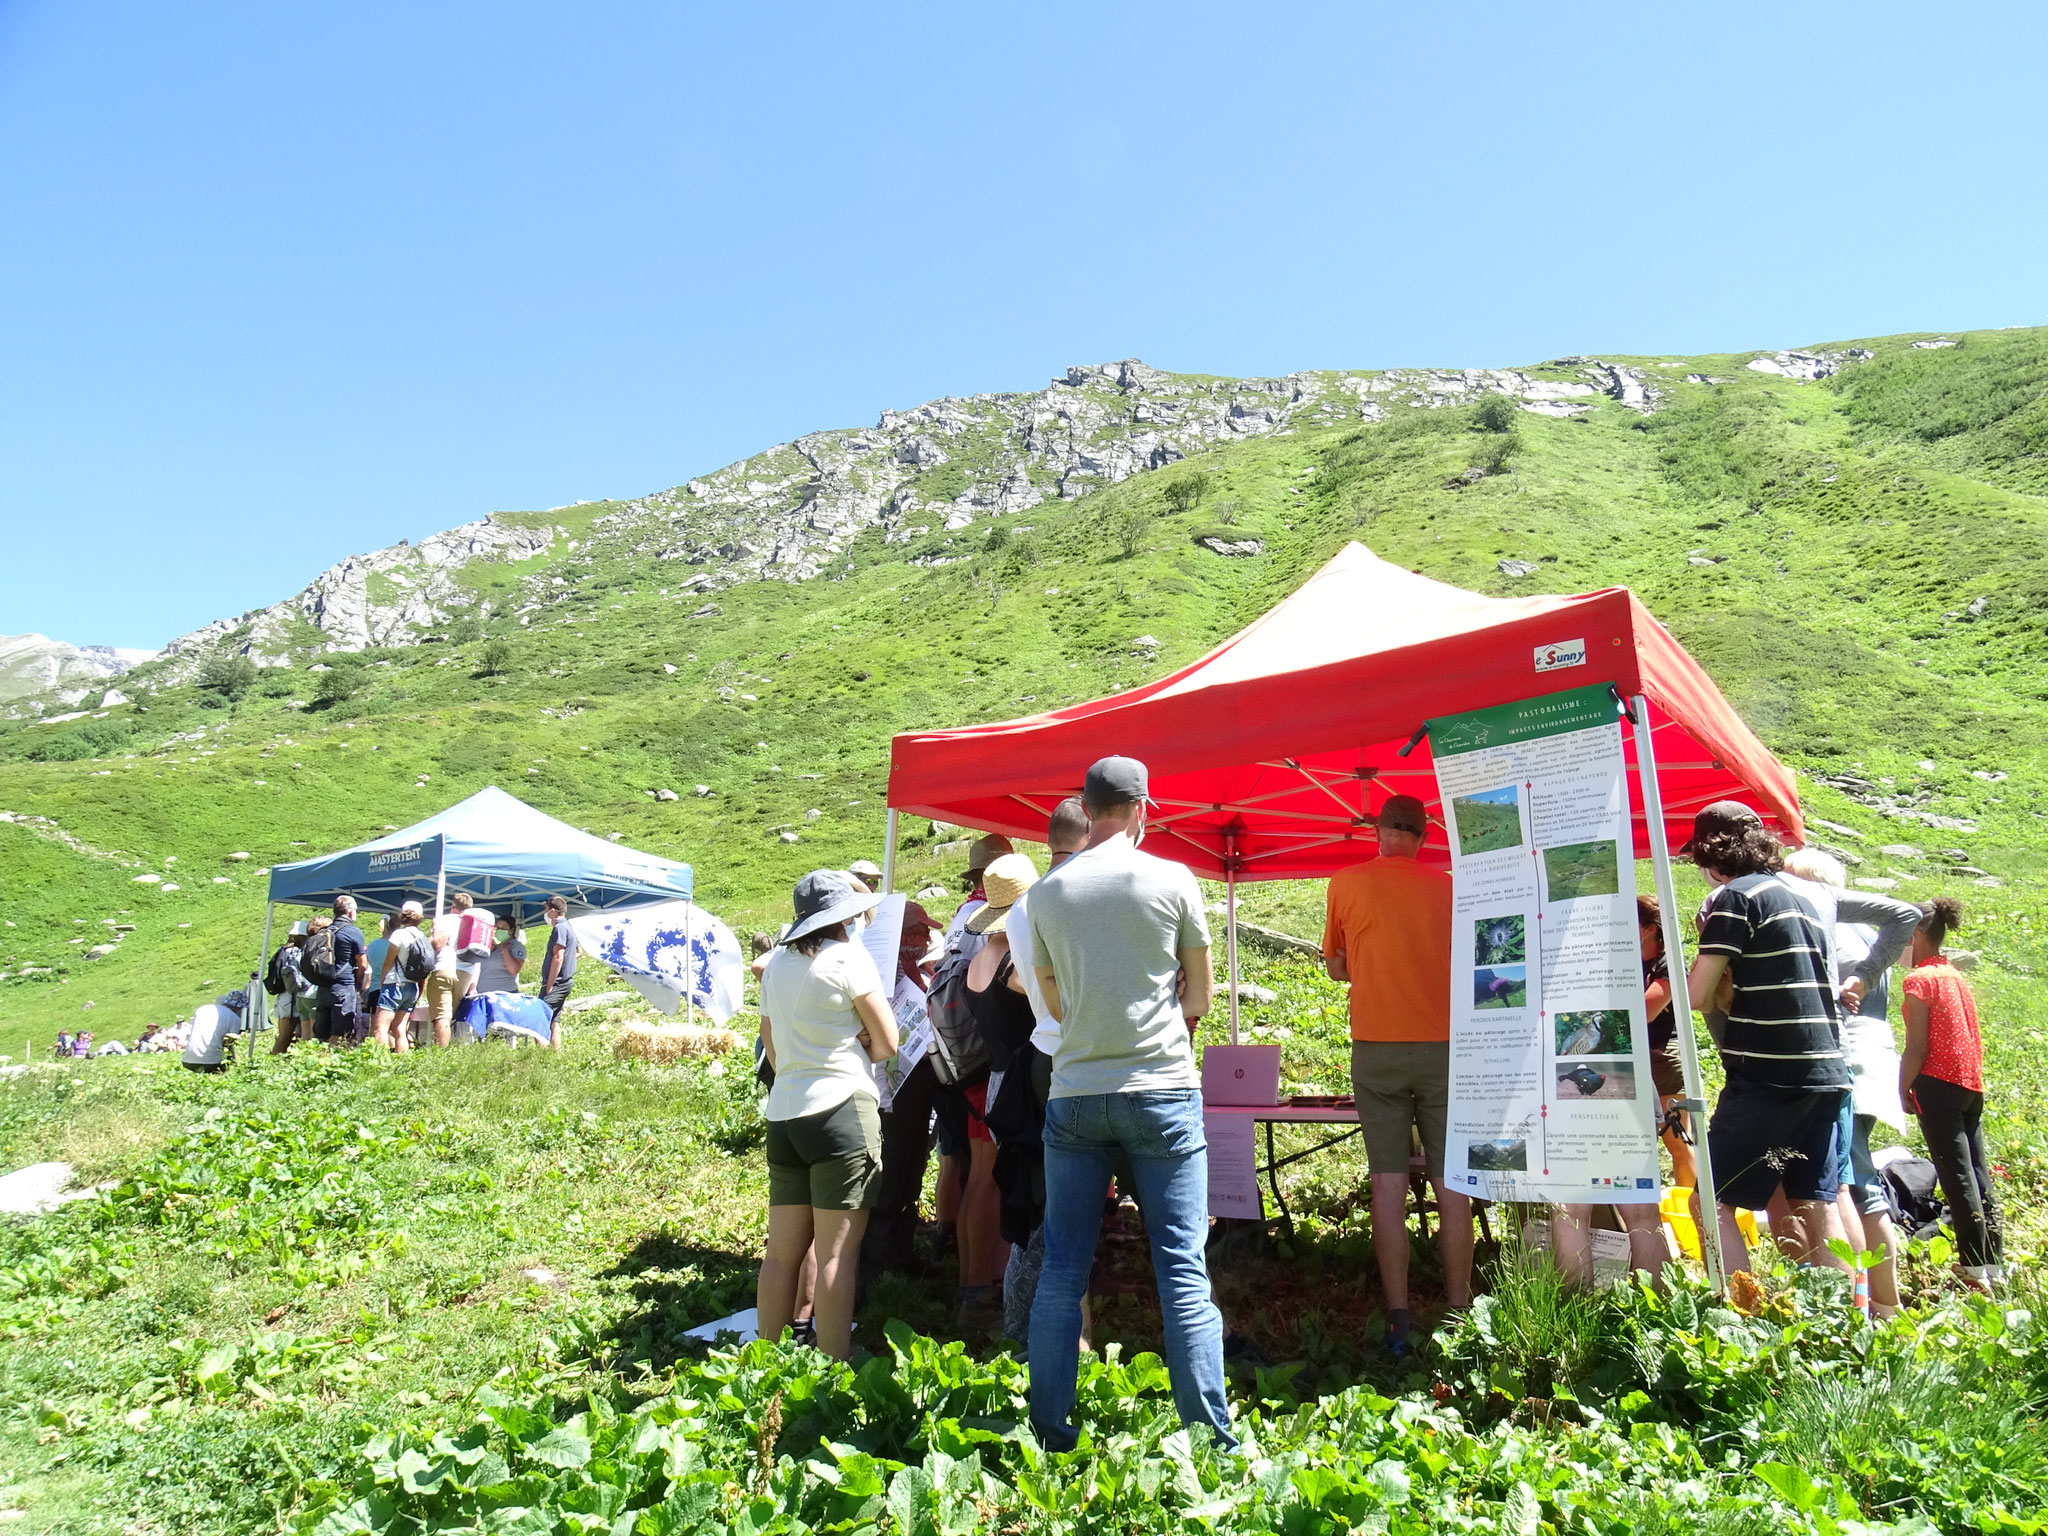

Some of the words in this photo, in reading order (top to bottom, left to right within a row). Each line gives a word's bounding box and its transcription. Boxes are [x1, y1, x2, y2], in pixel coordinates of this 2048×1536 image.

[1519, 700, 1580, 718] PASTORALISME
[1509, 725, 1536, 735] IMPACTS
[1537, 712, 1601, 729] ENVIRONNEMENTAUX
[369, 848, 421, 866] MASTERTENT
[1460, 859, 1496, 869] PRÉSERVATION
[1489, 862, 1520, 871] BIODIVERSITÉ
